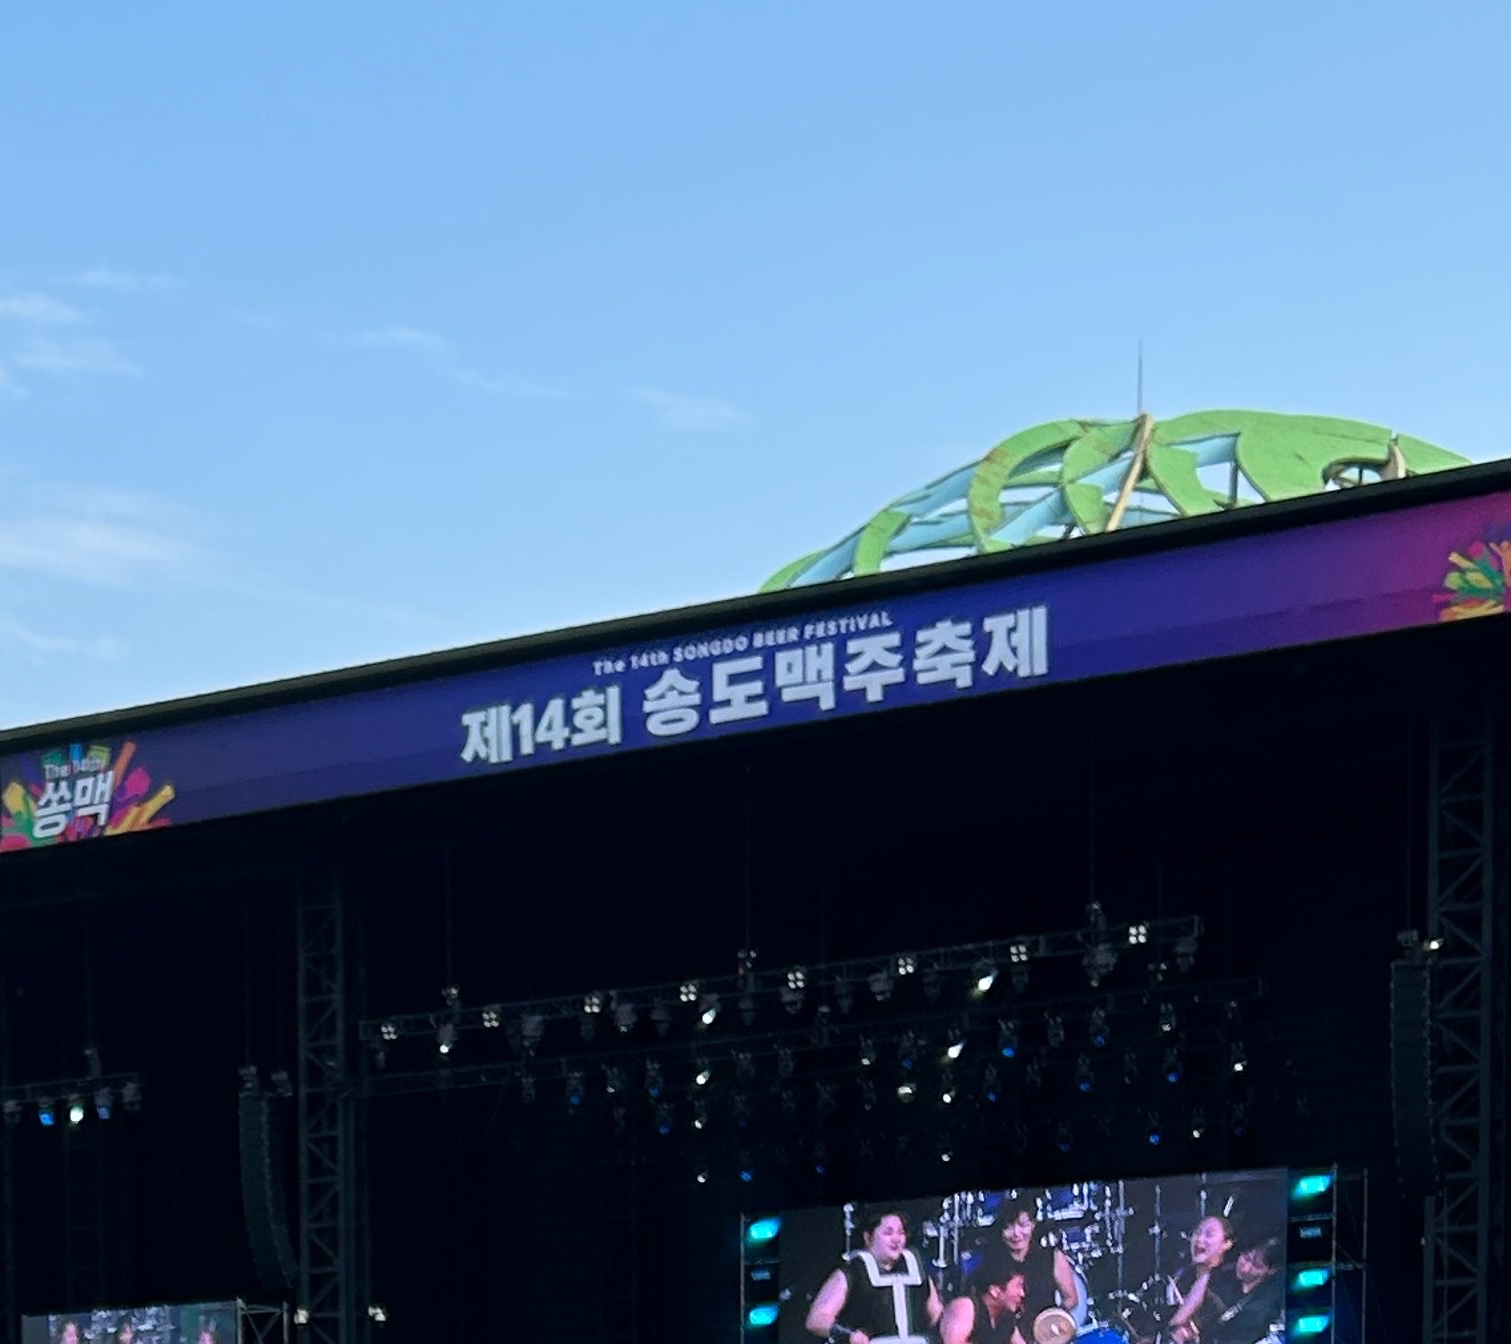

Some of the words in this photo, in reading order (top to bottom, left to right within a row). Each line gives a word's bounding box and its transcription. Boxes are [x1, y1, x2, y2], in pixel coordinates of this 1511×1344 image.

[460, 684, 623, 764] 제14회
[642, 604, 1049, 738] 송도맥주축제
[593, 659, 626, 676] The
[673, 635, 749, 664] SONGDO
[752, 626, 799, 649] BEER
[804, 610, 893, 640] FESTIVAL
